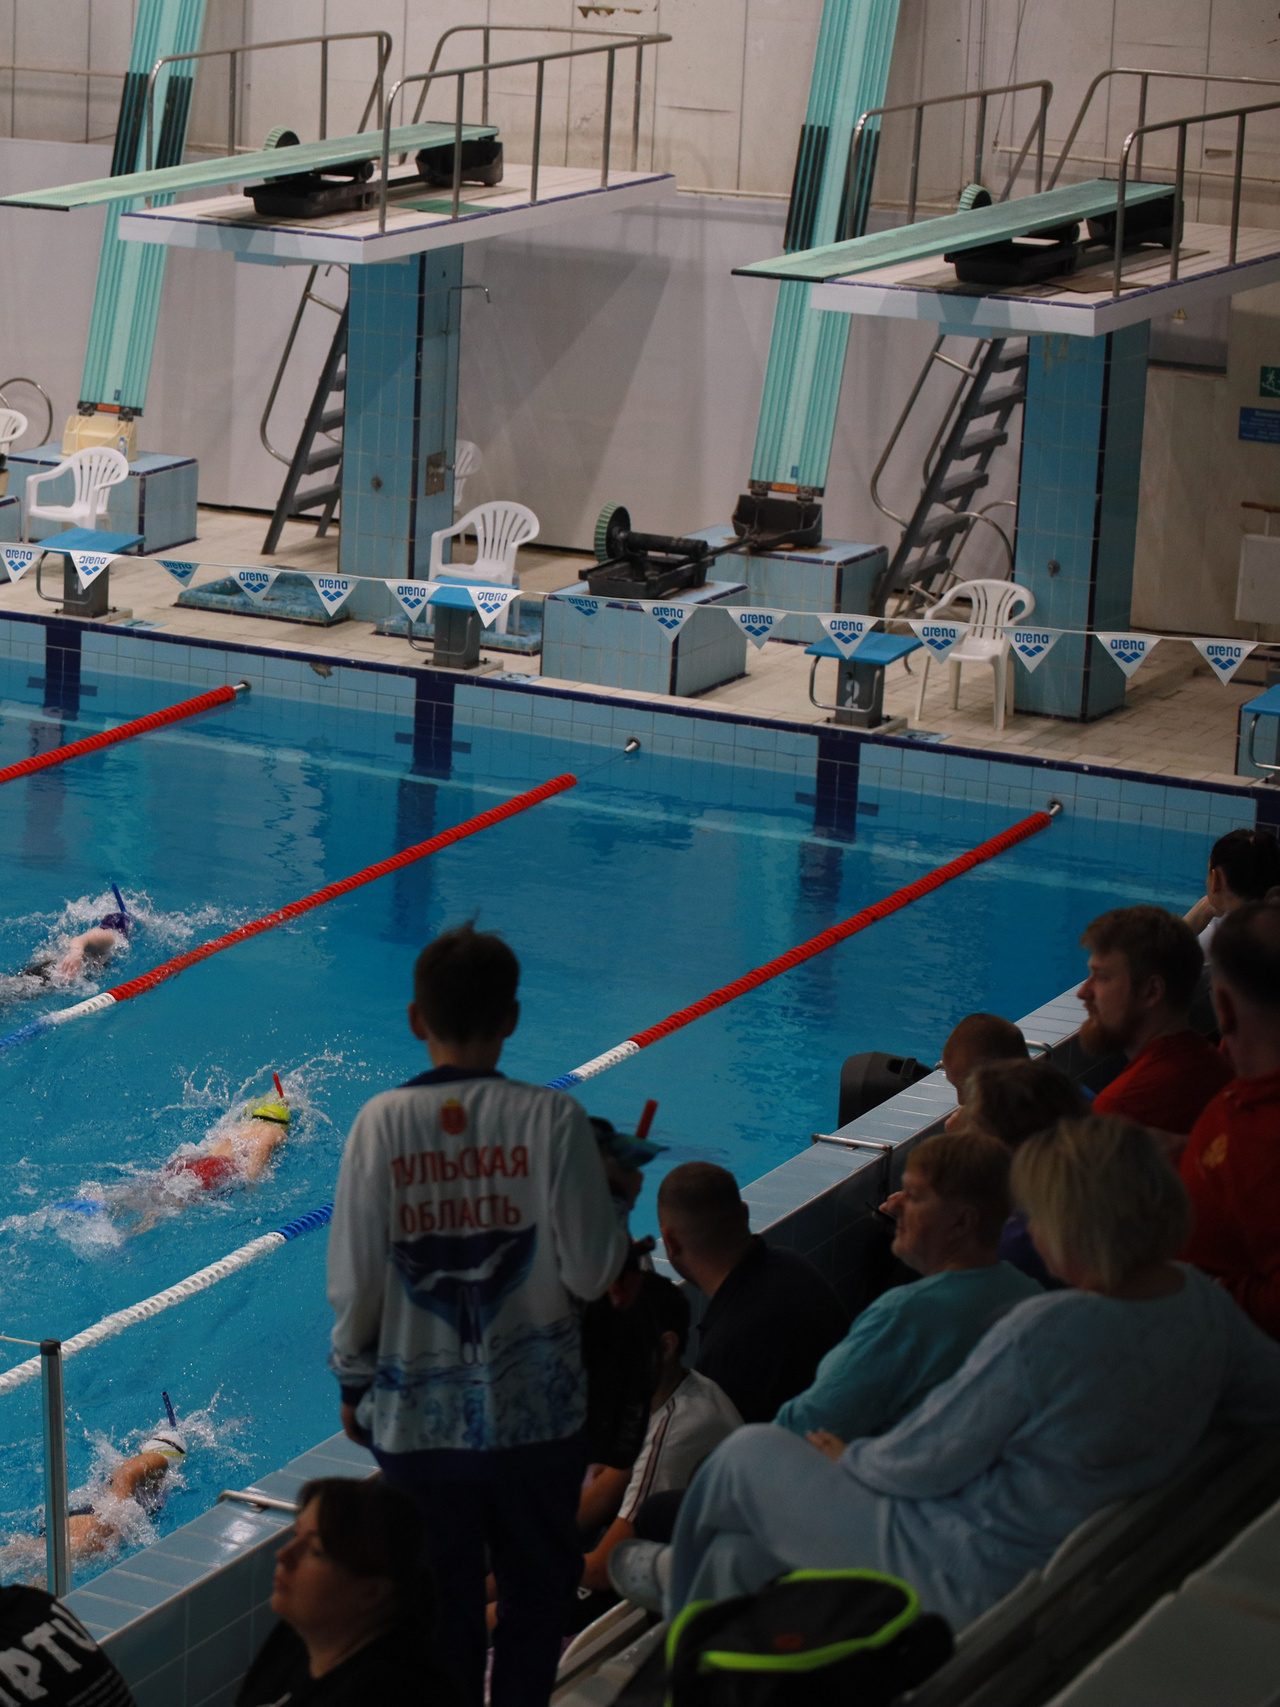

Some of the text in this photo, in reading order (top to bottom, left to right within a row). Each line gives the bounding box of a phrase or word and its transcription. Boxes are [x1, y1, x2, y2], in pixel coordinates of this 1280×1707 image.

[5, 548, 32, 561] arena
[78, 555, 107, 565] arena
[238, 571, 269, 582] arena
[318, 578, 348, 590] arena
[397, 585, 427, 597] arena
[477, 591, 508, 602] arena
[652, 605, 684, 619] arena
[740, 613, 773, 625] arena
[830, 619, 863, 632] arena
[922, 626, 956, 638] arena
[1014, 632, 1049, 644] arena
[1110, 639, 1145, 651] arena
[1206, 645, 1241, 658] arena
[844, 679, 860, 709] 2
[399, 1194, 521, 1235] ОБЛАСТЬ
